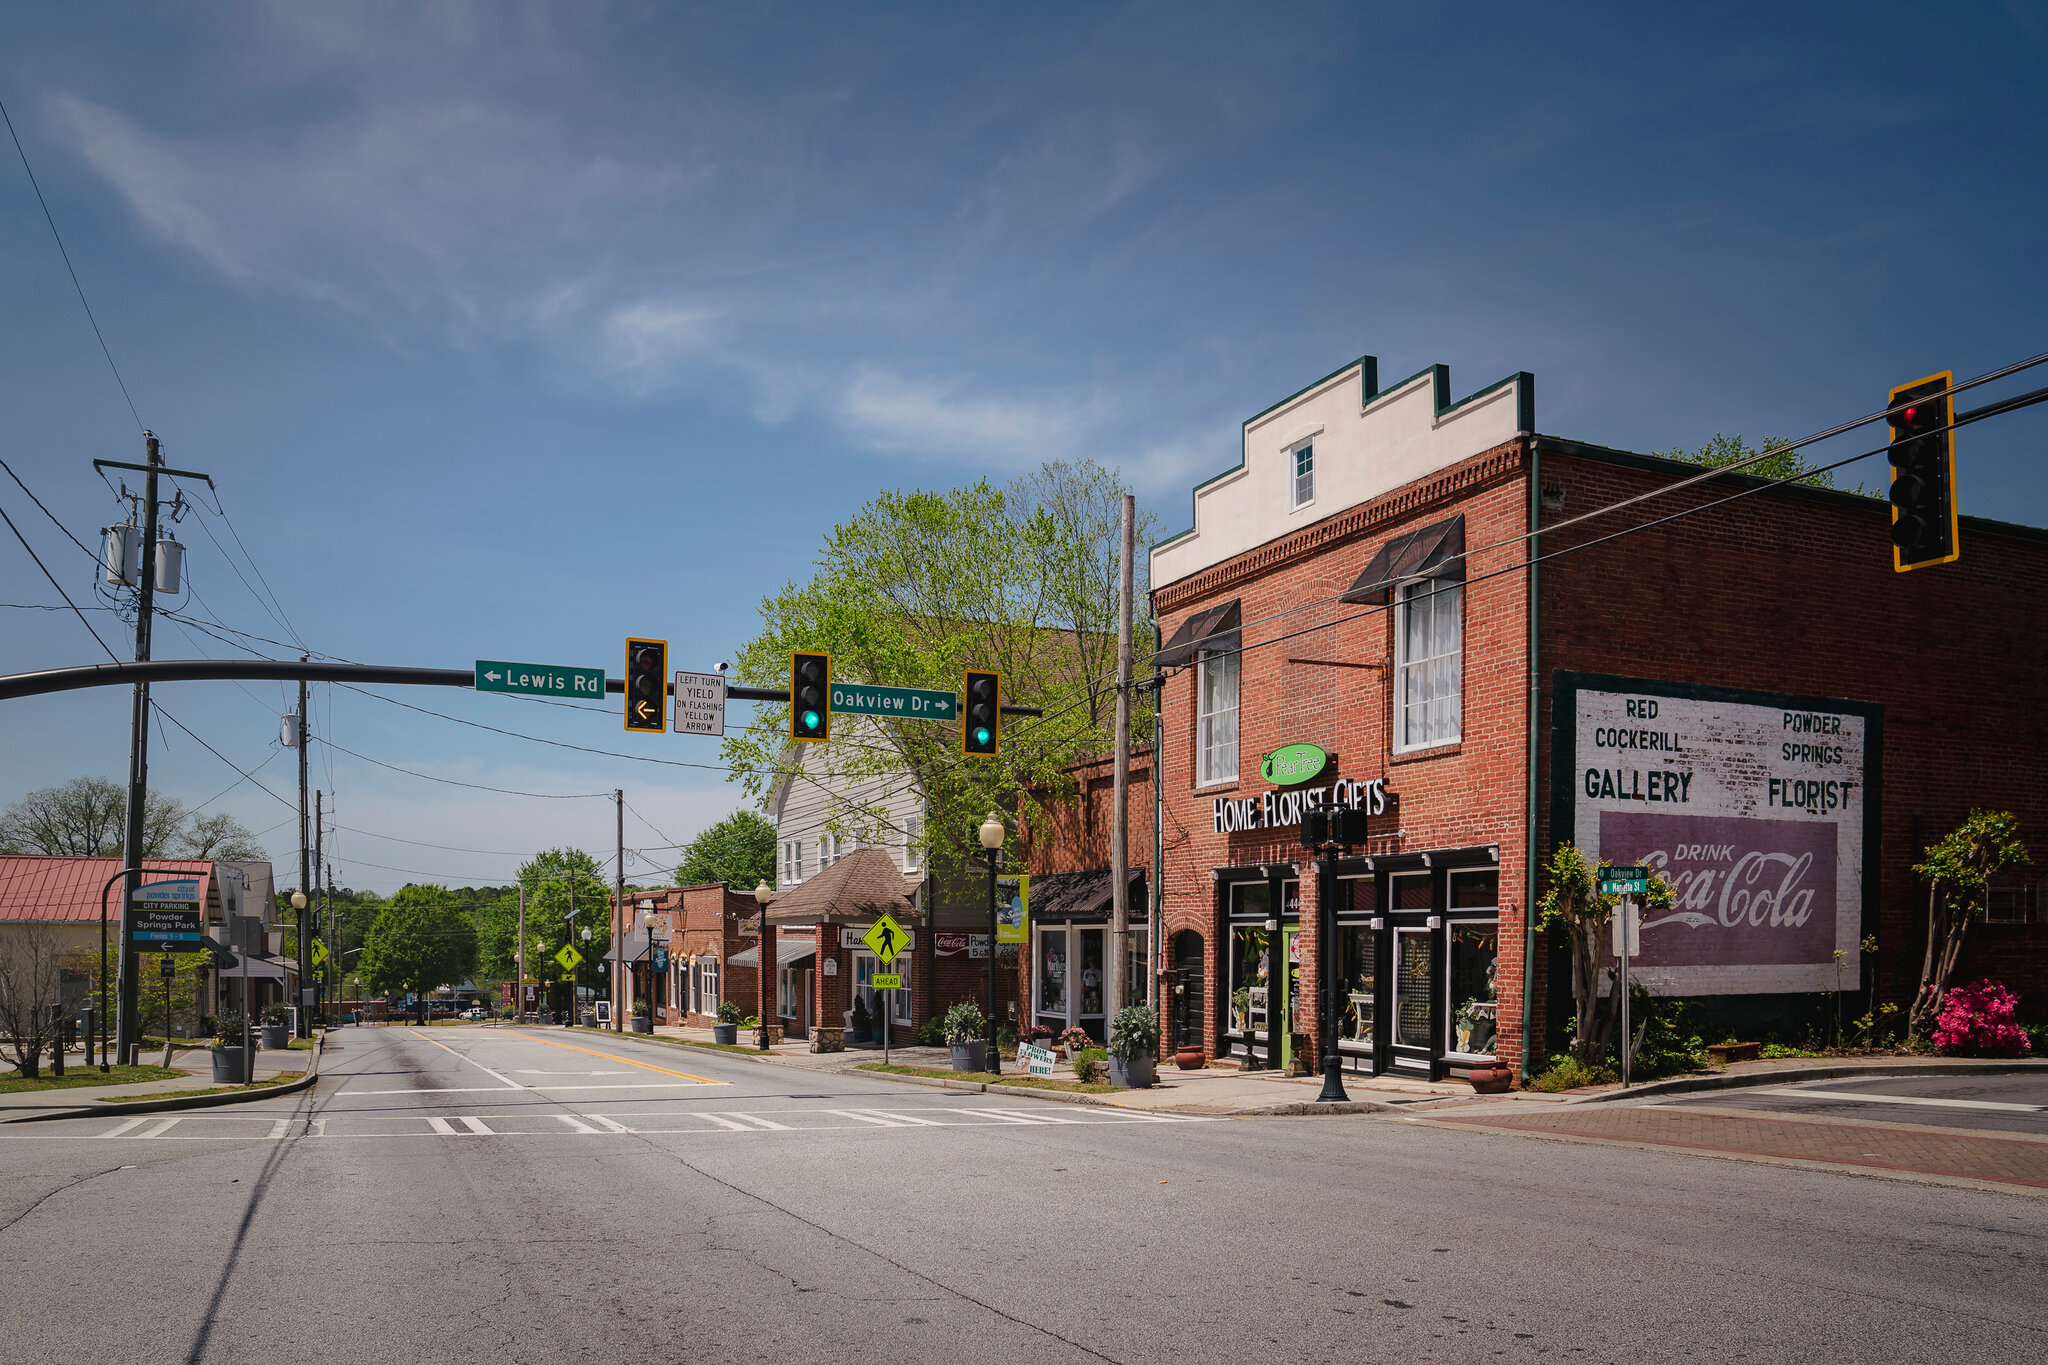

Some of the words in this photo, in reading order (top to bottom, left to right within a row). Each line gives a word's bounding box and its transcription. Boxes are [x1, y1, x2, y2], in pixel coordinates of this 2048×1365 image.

[507, 669, 565, 689] Lewis
[574, 674, 598, 692] Rd
[680, 676, 698, 685] LEFT
[701, 677, 721, 687] TURN
[687, 688, 714, 699] YIELD
[833, 690, 905, 710] Oakview
[912, 696, 930, 711] Dr
[677, 700, 687, 708] ON
[689, 701, 723, 711] FLASHING
[1626, 699, 1659, 719] RED
[684, 711, 715, 721] YELLOW
[685, 721, 713, 731] ARROW
[1783, 712, 1841, 735] POWDER
[1595, 727, 1683, 752] COCKERILL
[1782, 742, 1844, 764] SPRINGS
[1276, 755, 1298, 776] Pear
[1296, 751, 1320, 772] Tree
[1585, 768, 1693, 803] GALLERY
[1768, 778, 1853, 809] FLORIST
[1212, 797, 1256, 833] HOME
[1674, 844, 1735, 861] DRINK
[1610, 868, 1634, 878] Oakview
[1635, 868, 1642, 878] Dr
[1612, 882, 1633, 892] Maretta
[1634, 881, 1640, 891] St
[137, 921, 172, 930] Springs
[937, 937, 967, 948] Coca-Cola
[875, 978, 898, 986] AHEAD
[1020, 1049, 1053, 1064] FLOWERS
[1026, 1044, 1047, 1057] PROM
[1029, 1065, 1051, 1075] HERE!
